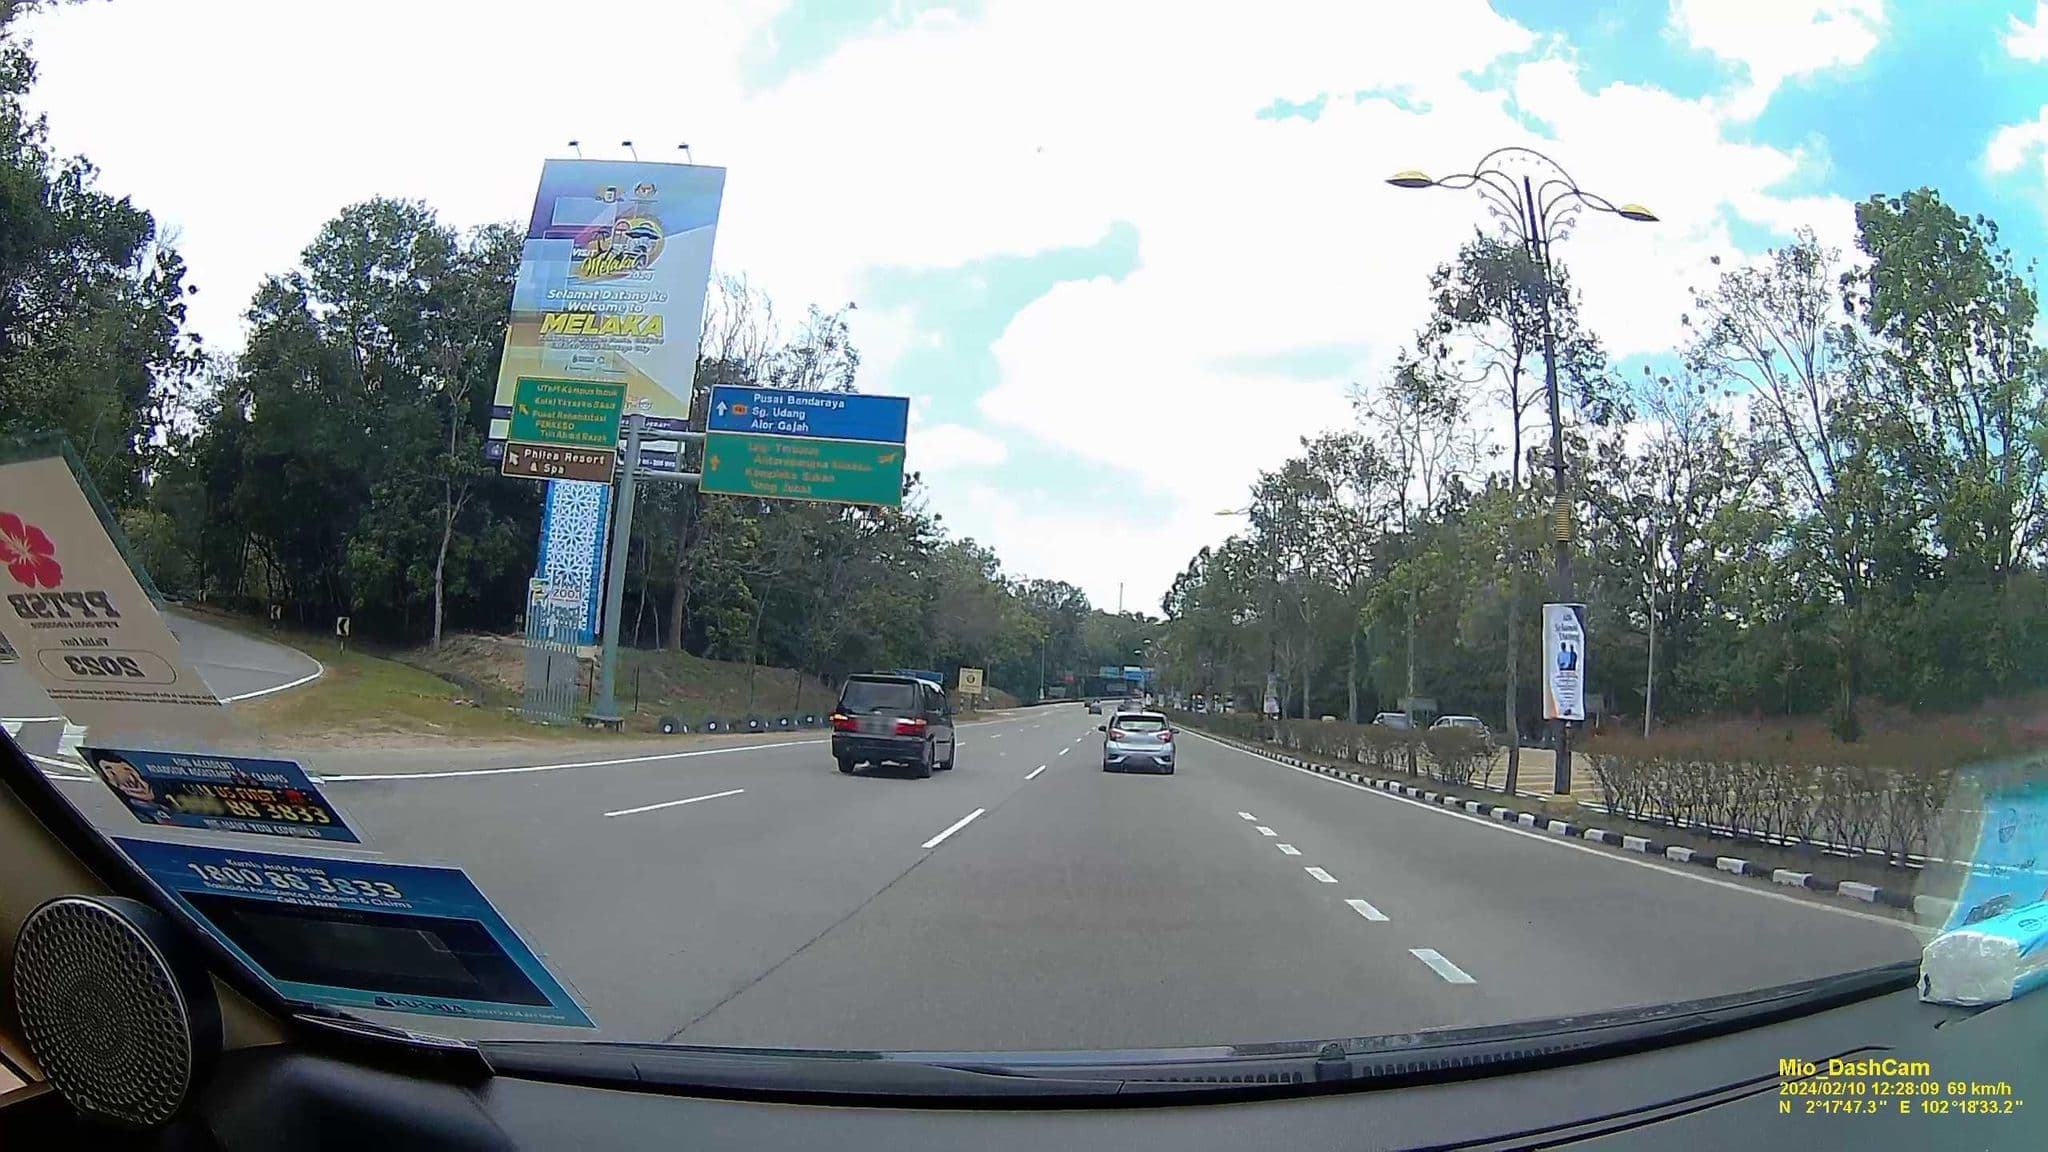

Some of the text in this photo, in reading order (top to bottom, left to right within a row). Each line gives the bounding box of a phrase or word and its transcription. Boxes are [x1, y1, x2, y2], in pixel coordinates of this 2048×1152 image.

[547, 289, 600, 301] Selamat
[601, 291, 649, 305] Datang
[567, 300, 643, 313] Welcome to
[540, 313, 663, 336] MELAKA
[754, 393, 846, 410] Pusat Bandaraya
[751, 407, 770, 418] Sg.
[773, 408, 806, 421] Udang
[751, 419, 809, 433] Alor Gajah
[564, 450, 605, 464] Resort
[543, 462, 565, 475] Spa
[215, 785, 236, 799] US
[225, 800, 261, 818] 88
[264, 802, 330, 823] 3833
[187, 863, 401, 899] 1800 88 3833
[370, 899, 413, 909] Claims
